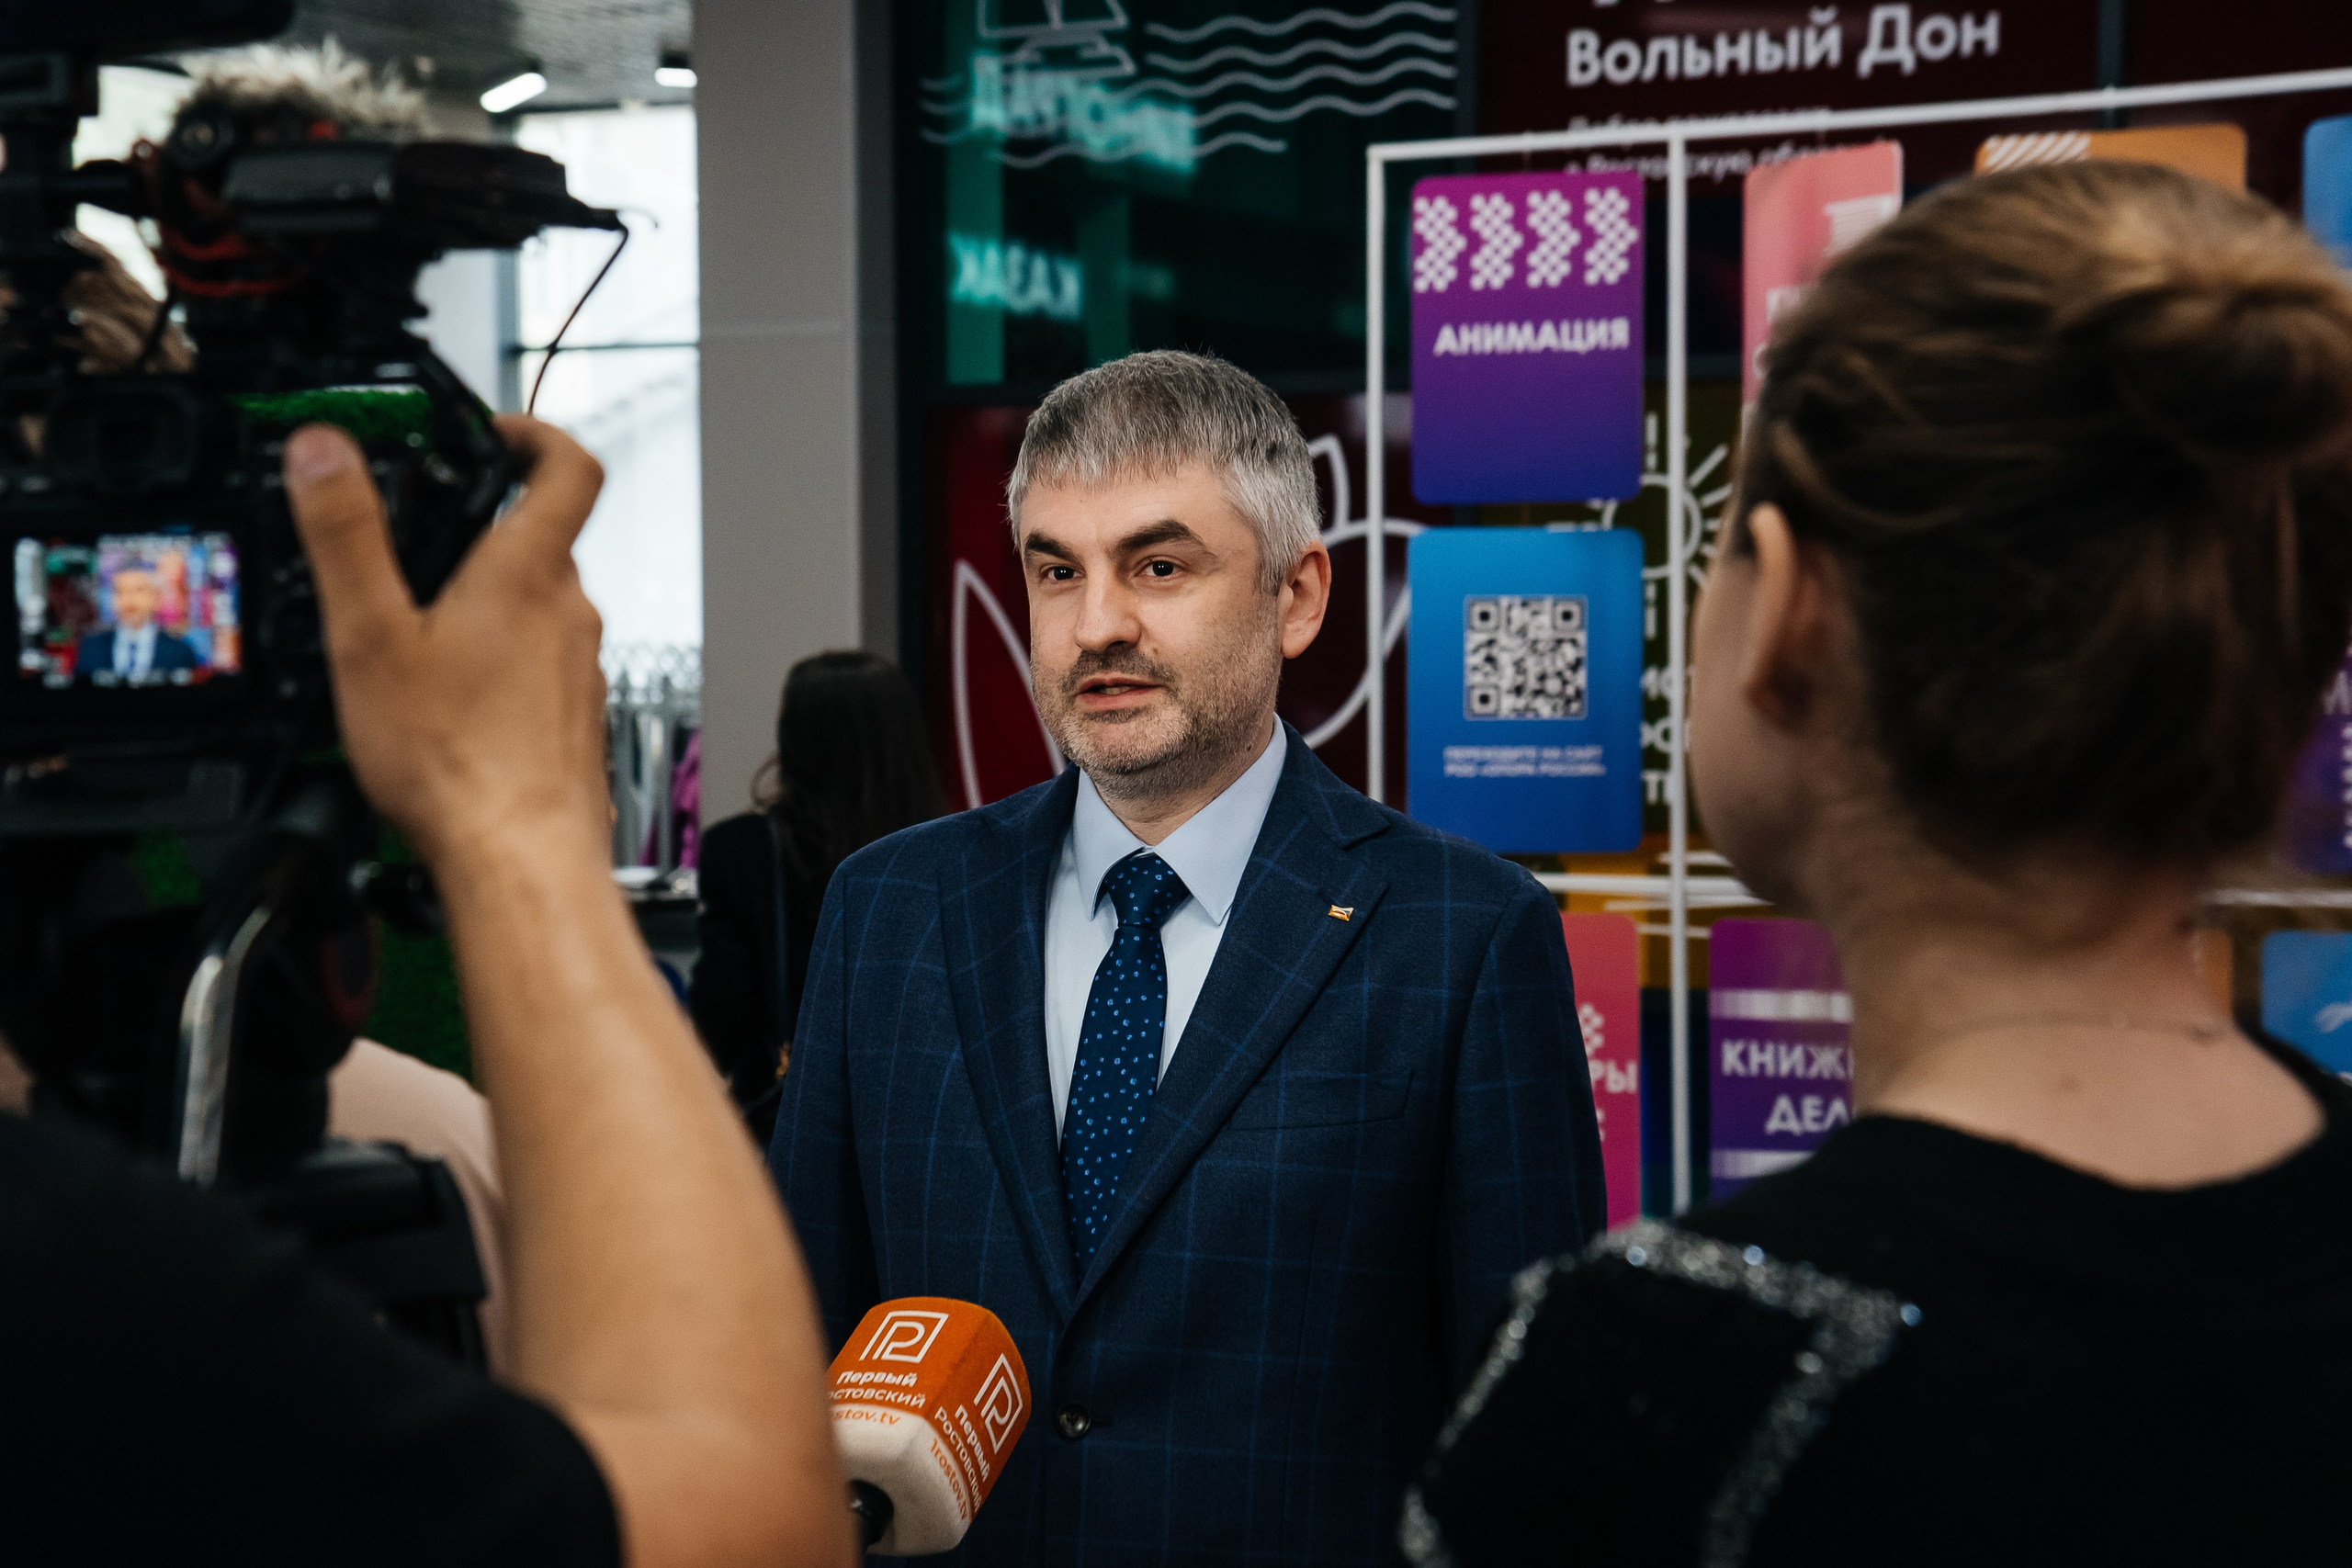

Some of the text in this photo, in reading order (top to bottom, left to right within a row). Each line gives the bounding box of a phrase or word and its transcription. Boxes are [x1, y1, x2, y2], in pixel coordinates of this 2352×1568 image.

[1566, 3, 2001, 86] Вольный Дон
[1433, 317, 1629, 356] АНИМАЦИЯ
[1721, 1039, 1854, 1079] КНИЖ
[1765, 1095, 1854, 1135] ДЕЛ
[828, 1388, 926, 1408] остовский
[836, 1371, 917, 1388] Первый
[835, 1408, 900, 1426] stov.tv
[955, 1404, 989, 1483] Первый
